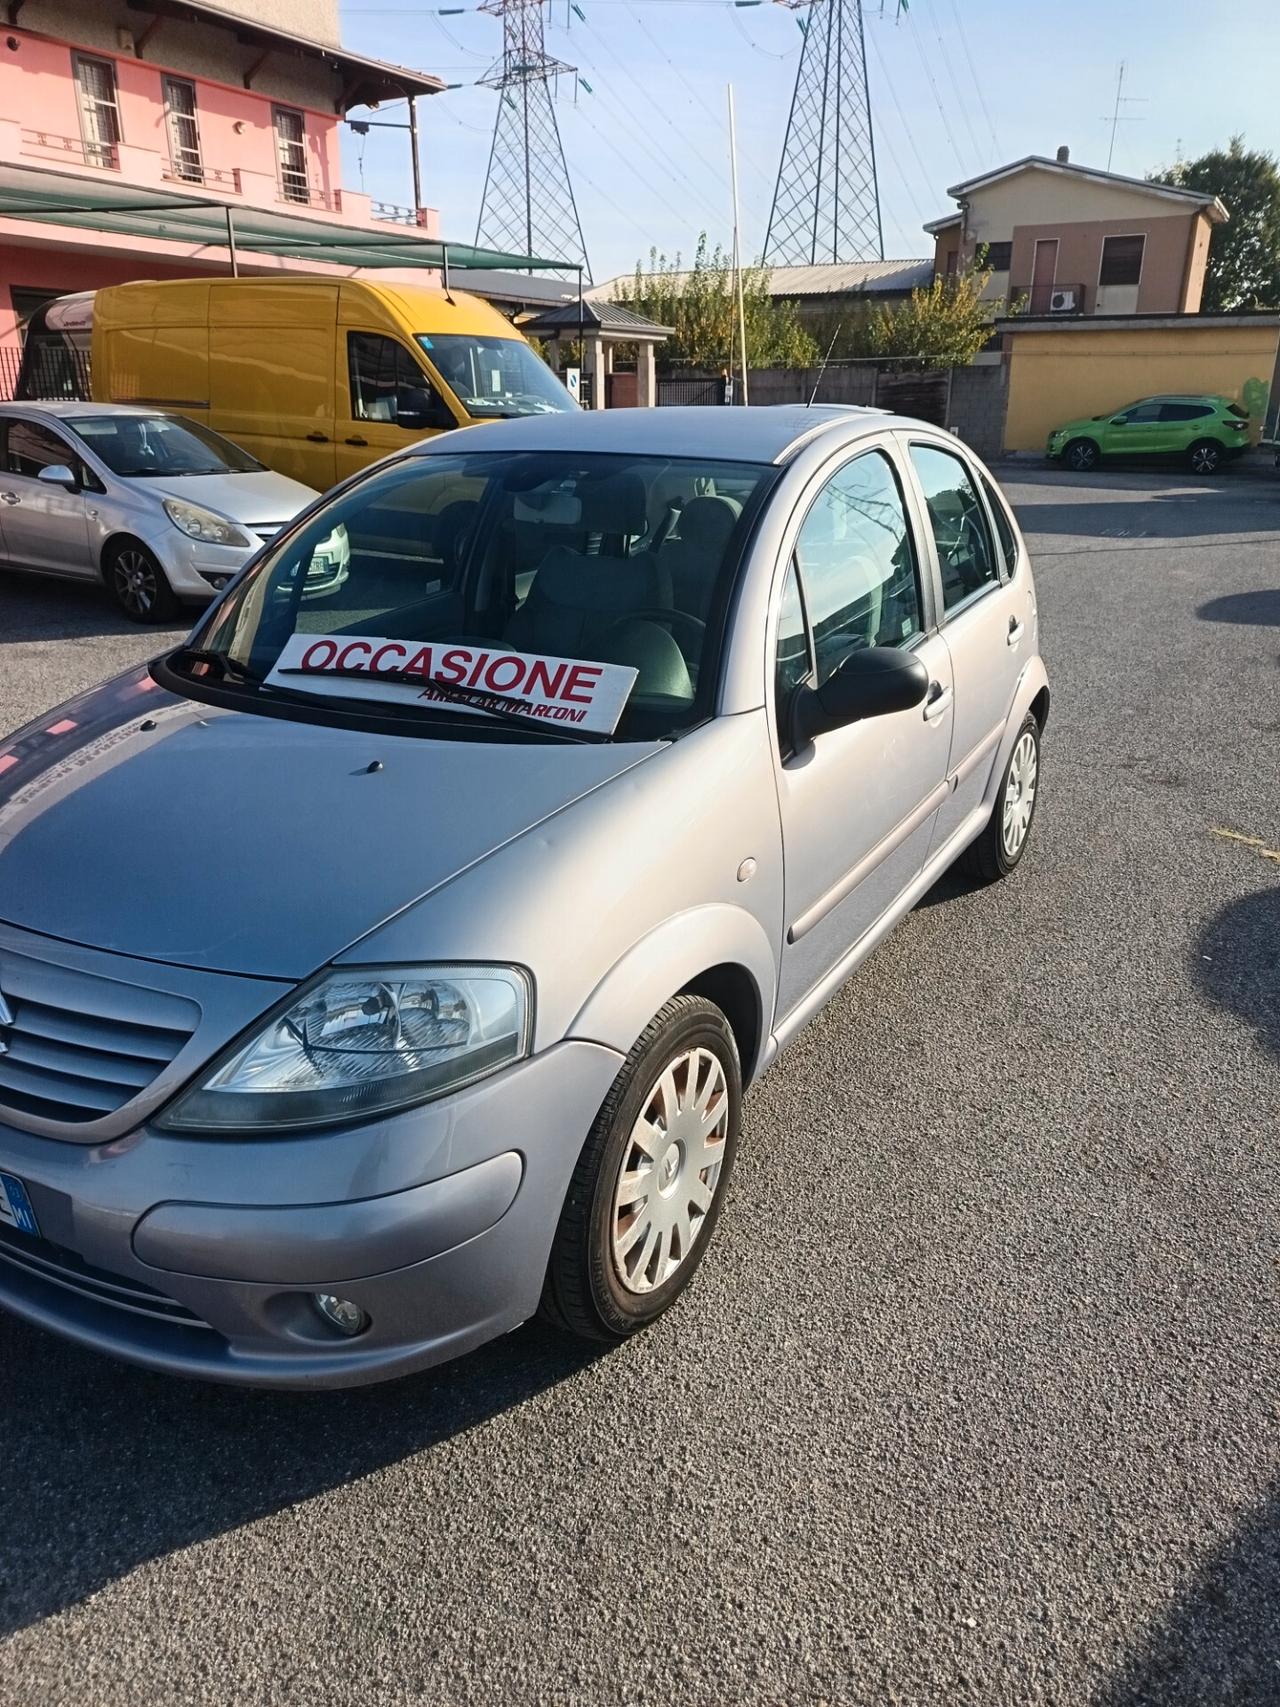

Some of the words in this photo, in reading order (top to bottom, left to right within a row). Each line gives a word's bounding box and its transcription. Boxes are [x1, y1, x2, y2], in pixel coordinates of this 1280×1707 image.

[302, 640, 603, 704] OCCASIONE
[500, 699, 588, 722] MARCONI
[11, 1204, 32, 1229] MI
